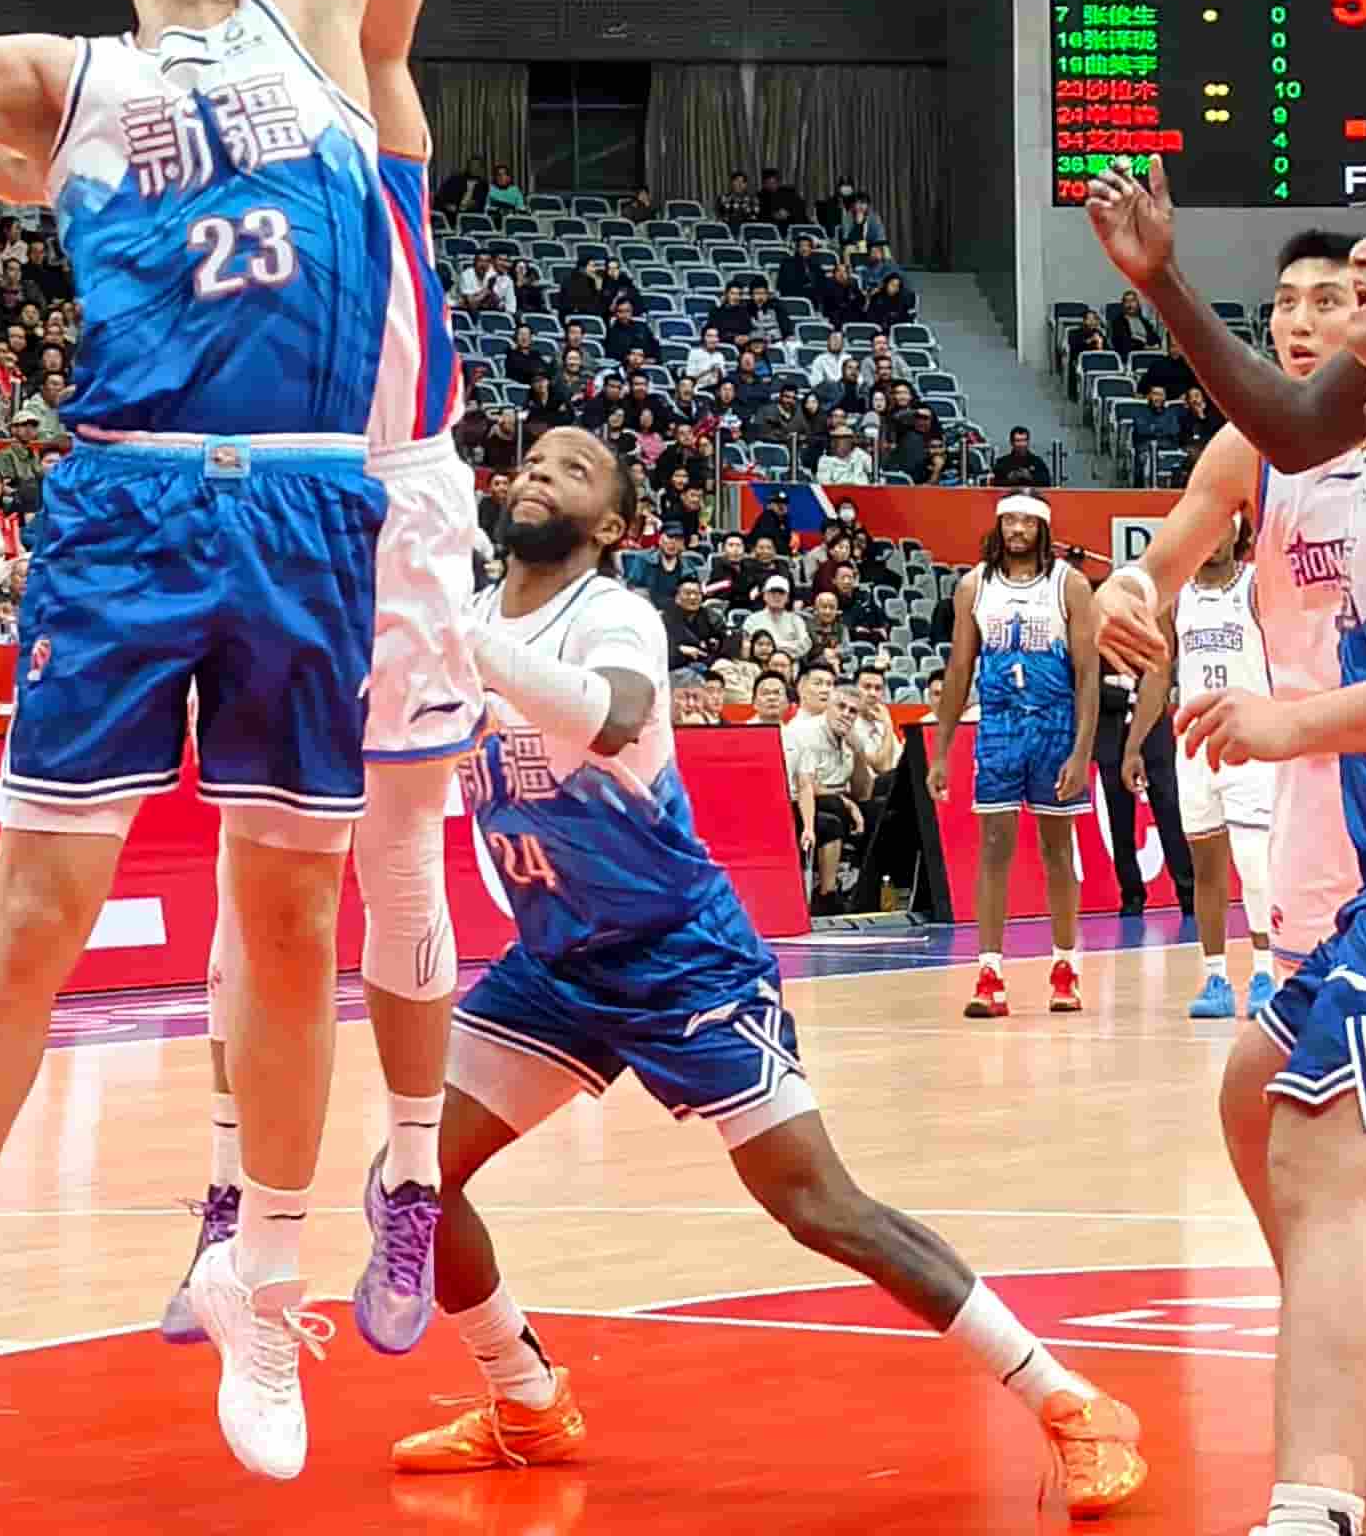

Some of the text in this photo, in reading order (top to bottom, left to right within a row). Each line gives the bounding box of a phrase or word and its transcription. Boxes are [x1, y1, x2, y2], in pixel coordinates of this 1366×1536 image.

[1053, 5, 1069, 23] 7
[1270, 6, 1286, 24] 0
[1271, 32, 1287, 49] 0
[1271, 56, 1287, 74] 0
[1274, 80, 1303, 99] 10
[1273, 155, 1289, 174] 0
[187, 205, 299, 301] 23
[1011, 663, 1025, 689] 1
[1201, 664, 1228, 689] 29
[488, 830, 558, 890] 24
